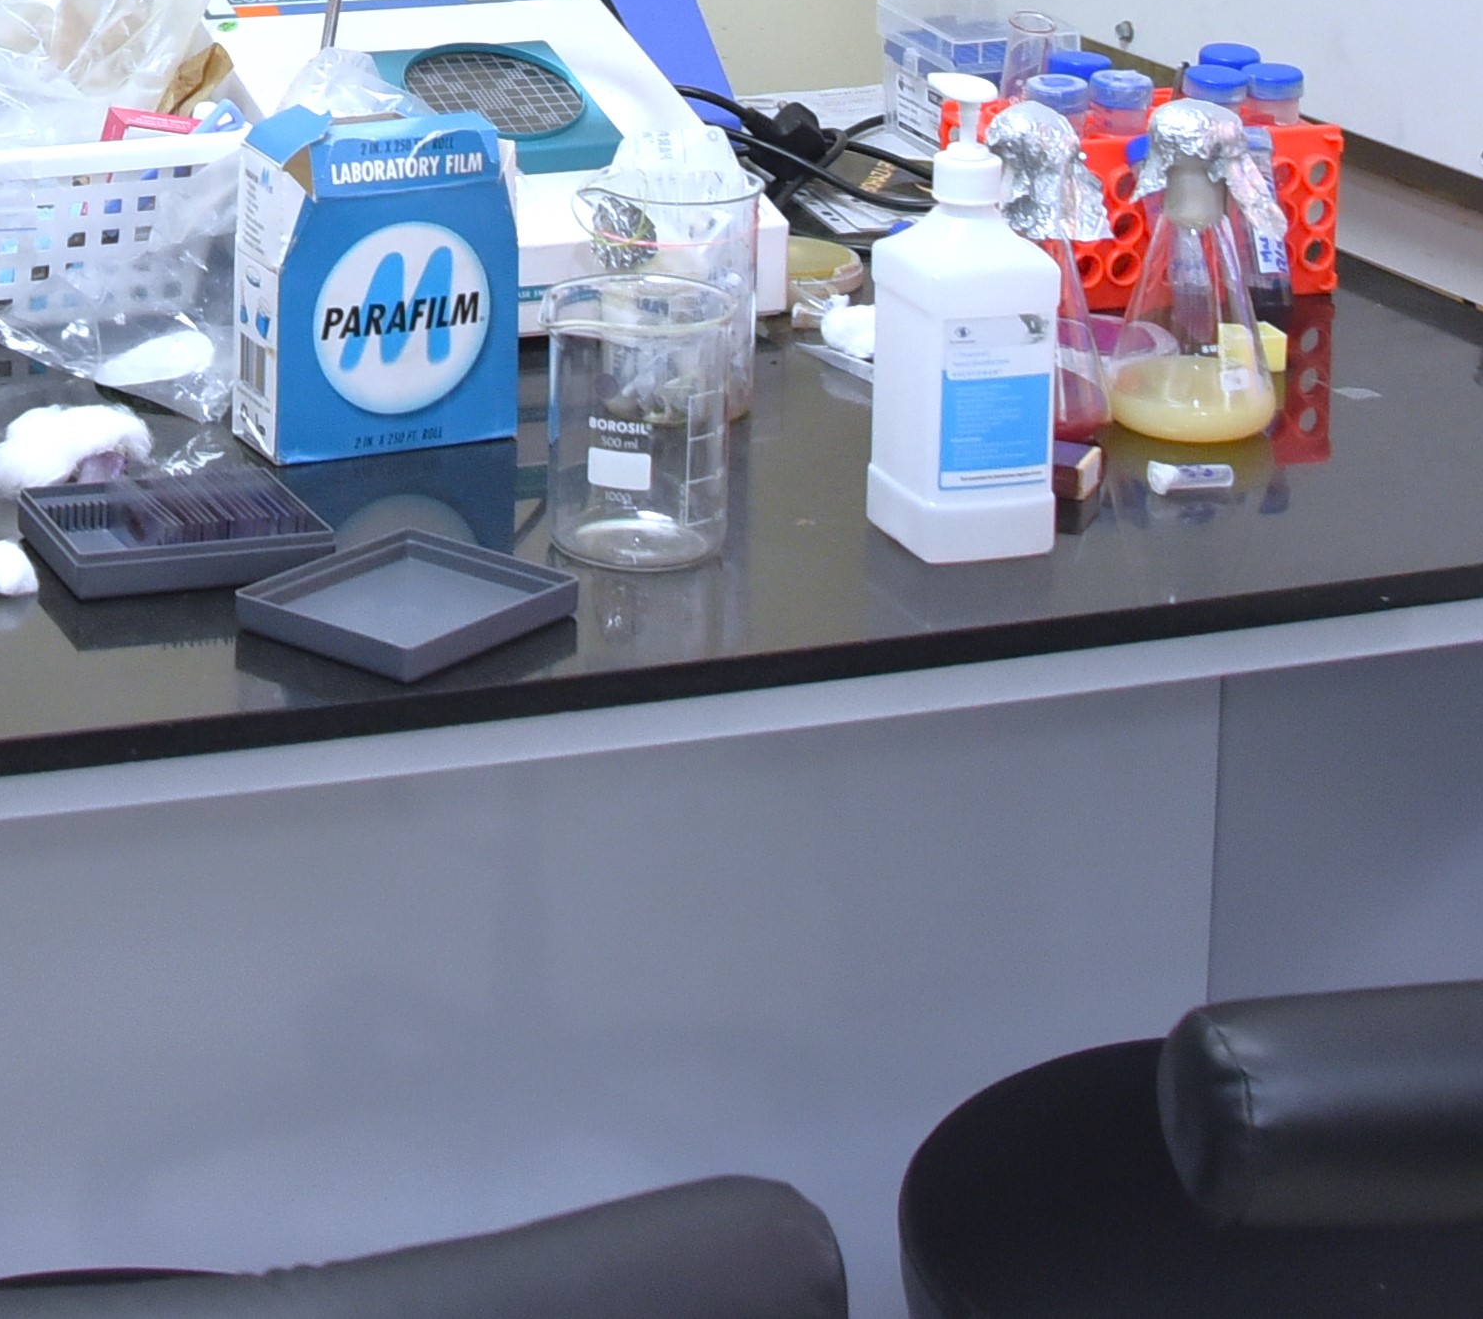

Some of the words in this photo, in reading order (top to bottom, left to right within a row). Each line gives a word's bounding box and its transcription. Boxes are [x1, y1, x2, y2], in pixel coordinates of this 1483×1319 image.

[331, 156, 440, 186] LABORATORY
[444, 151, 483, 175] FILM
[320, 290, 480, 341] PARAFILM
[589, 416, 647, 435] BOROSIL
